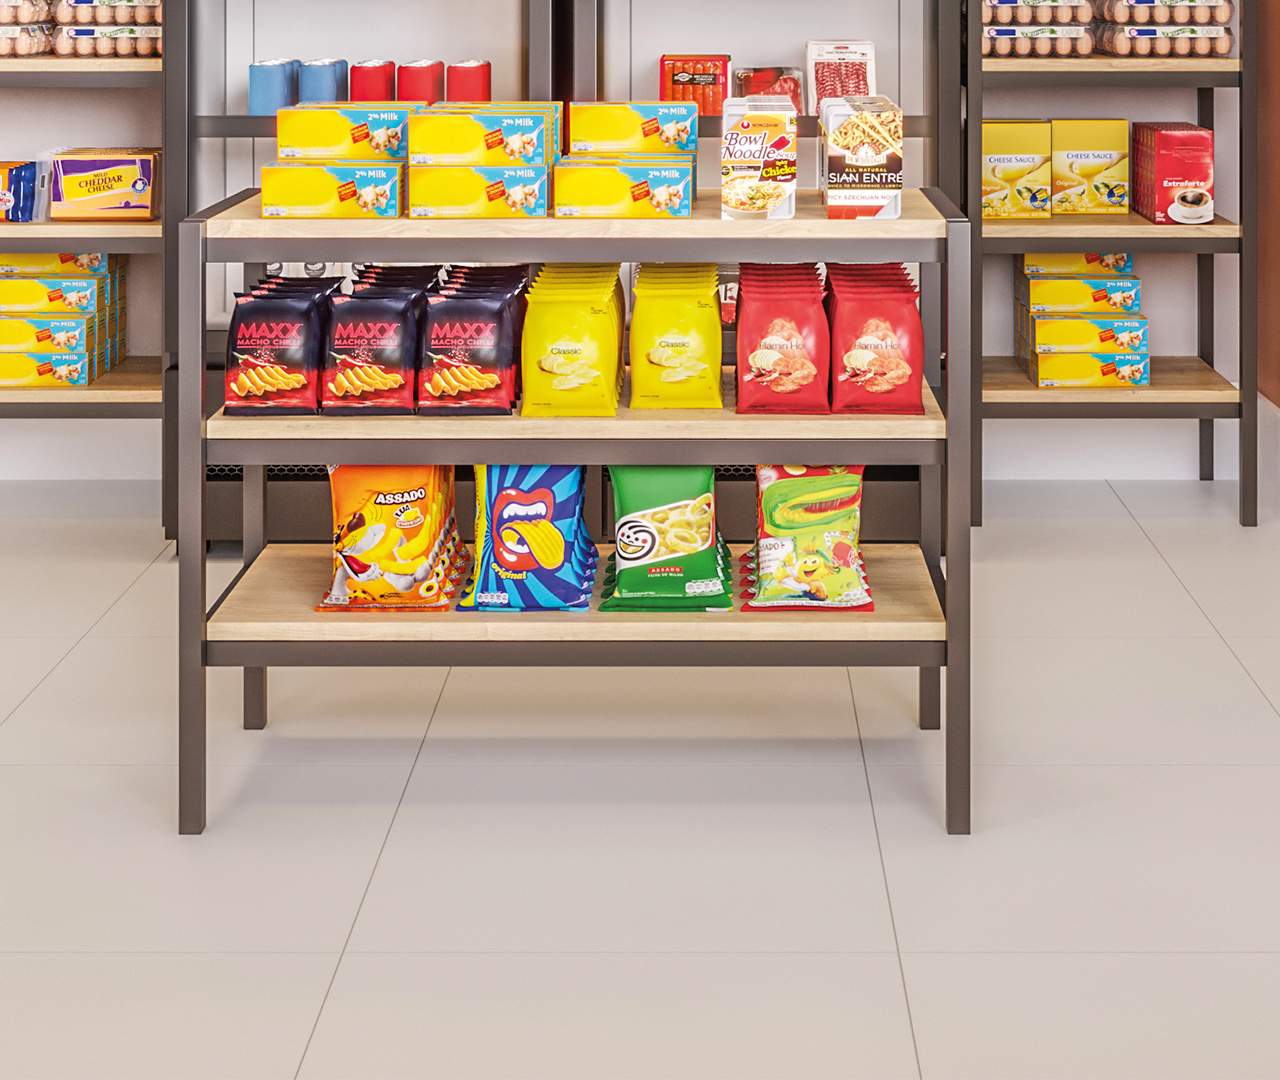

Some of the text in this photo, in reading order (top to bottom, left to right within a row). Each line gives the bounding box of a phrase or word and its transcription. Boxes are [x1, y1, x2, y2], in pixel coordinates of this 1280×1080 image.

[383, 112, 398, 120] Milk
[670, 107, 687, 115] Milk
[518, 117, 533, 126] Milk
[724, 132, 767, 146] Bowl
[722, 147, 776, 160] Noodle
[368, 170, 386, 178] Milk
[518, 169, 535, 178] Milk
[662, 170, 679, 178] Milk
[79, 175, 123, 187] CHEDDAR
[87, 184, 115, 193] CHEESE
[237, 323, 300, 338] MAXX
[335, 323, 397, 338] MAXX
[431, 323, 494, 338] MAXX
[759, 341, 805, 350] Flamin Hot
[854, 341, 900, 350] Flamin Hot
[375, 488, 426, 505] ASSADO
[395, 505, 410, 517] LUA
[491, 563, 527, 579] original
